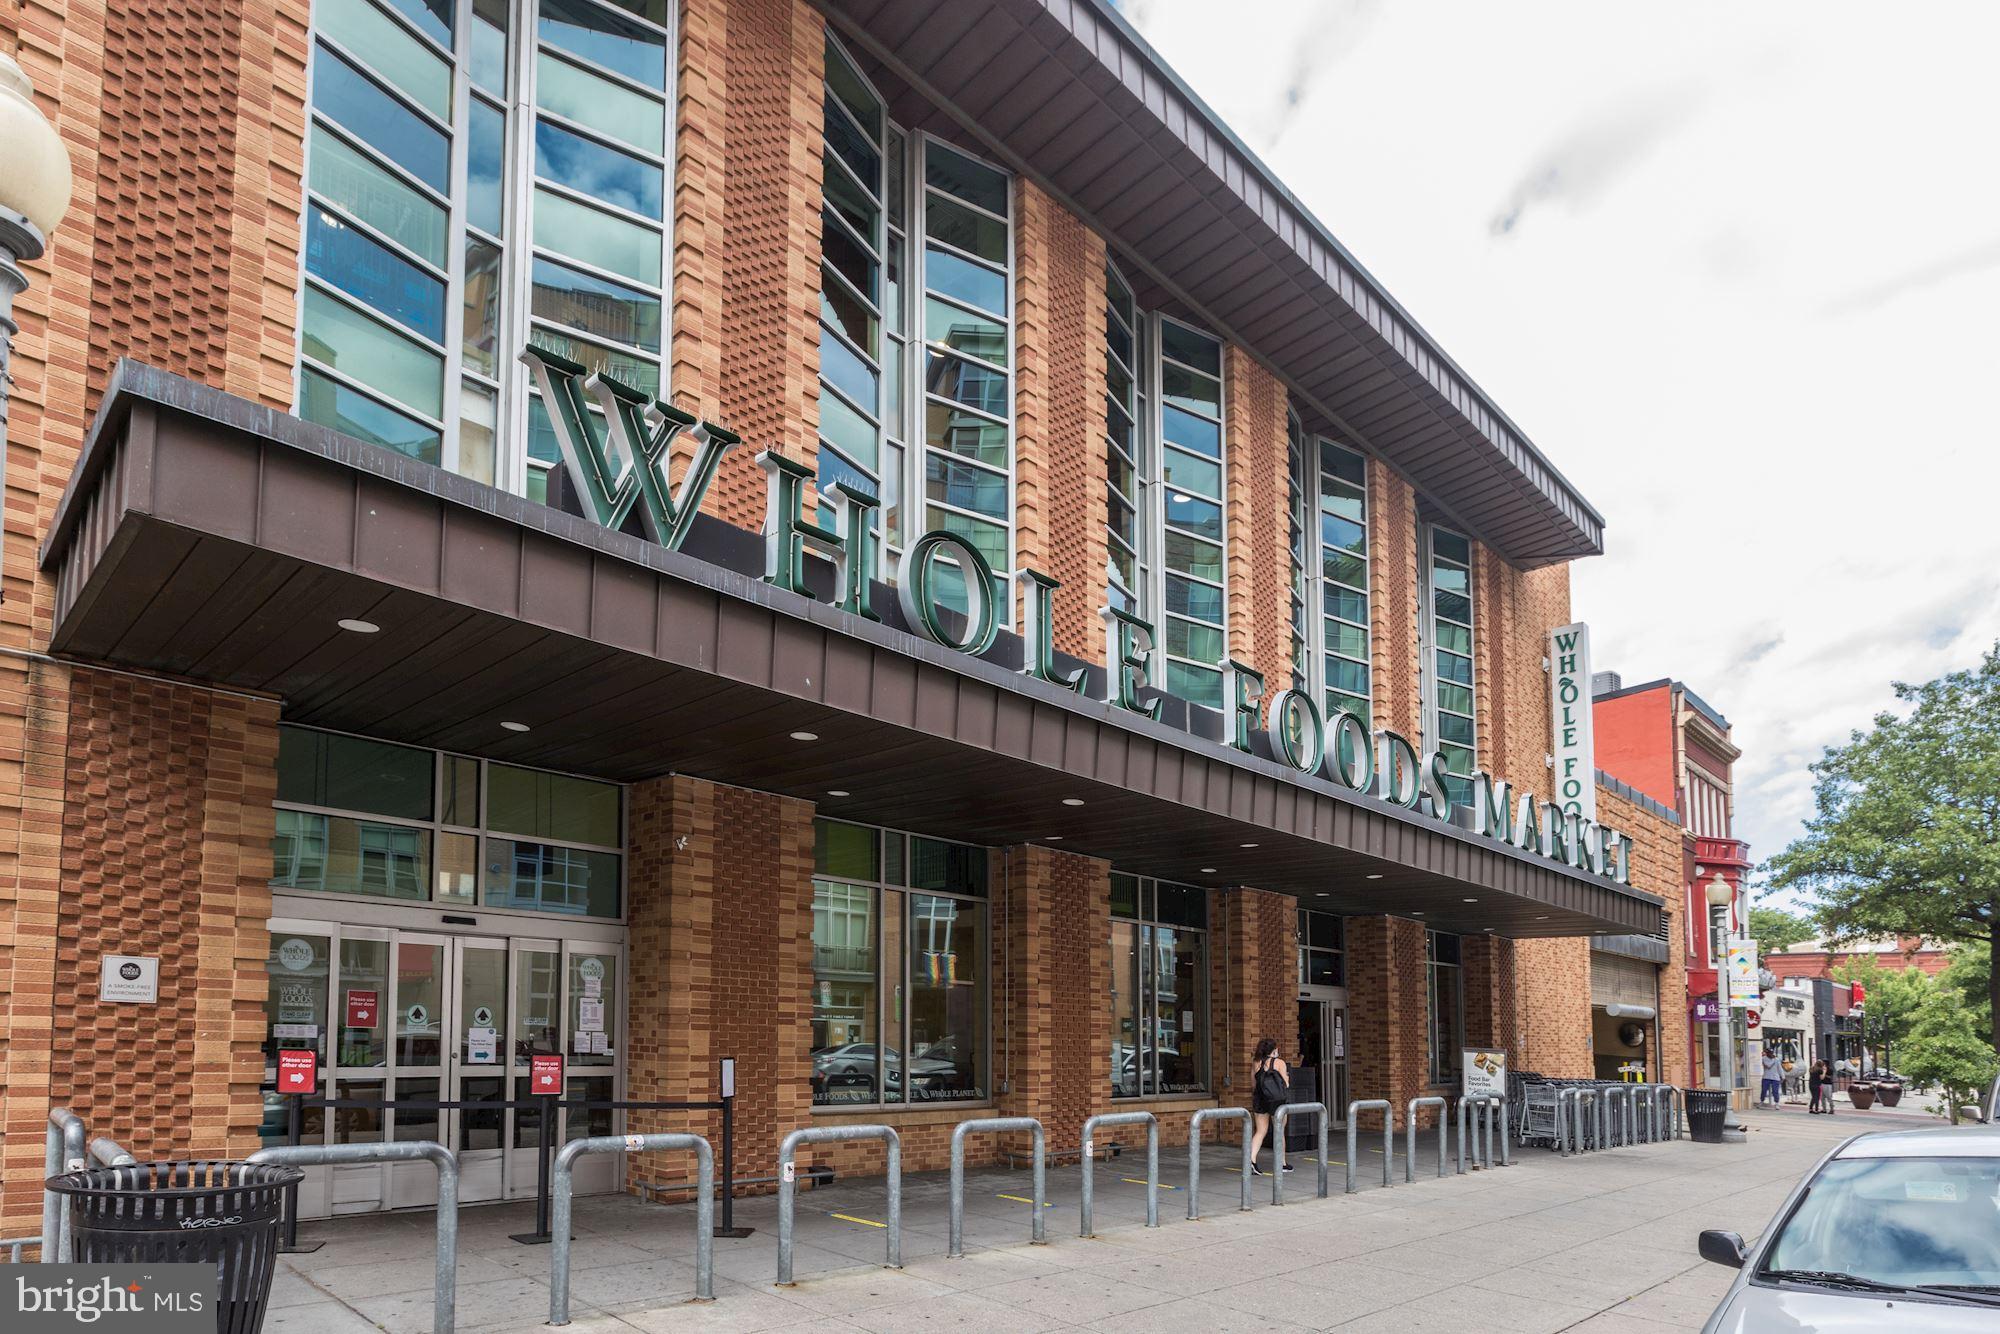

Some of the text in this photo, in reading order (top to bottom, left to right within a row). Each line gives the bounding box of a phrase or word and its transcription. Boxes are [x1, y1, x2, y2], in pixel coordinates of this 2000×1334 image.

[518, 343, 1633, 886] WHOLE FOODS MARKET
[1555, 631, 1580, 748] WHOLE
[280, 985, 314, 996] WHOLE
[281, 995, 313, 1003] FOODS
[930, 1089, 975, 1098] WHOLE PLANET
